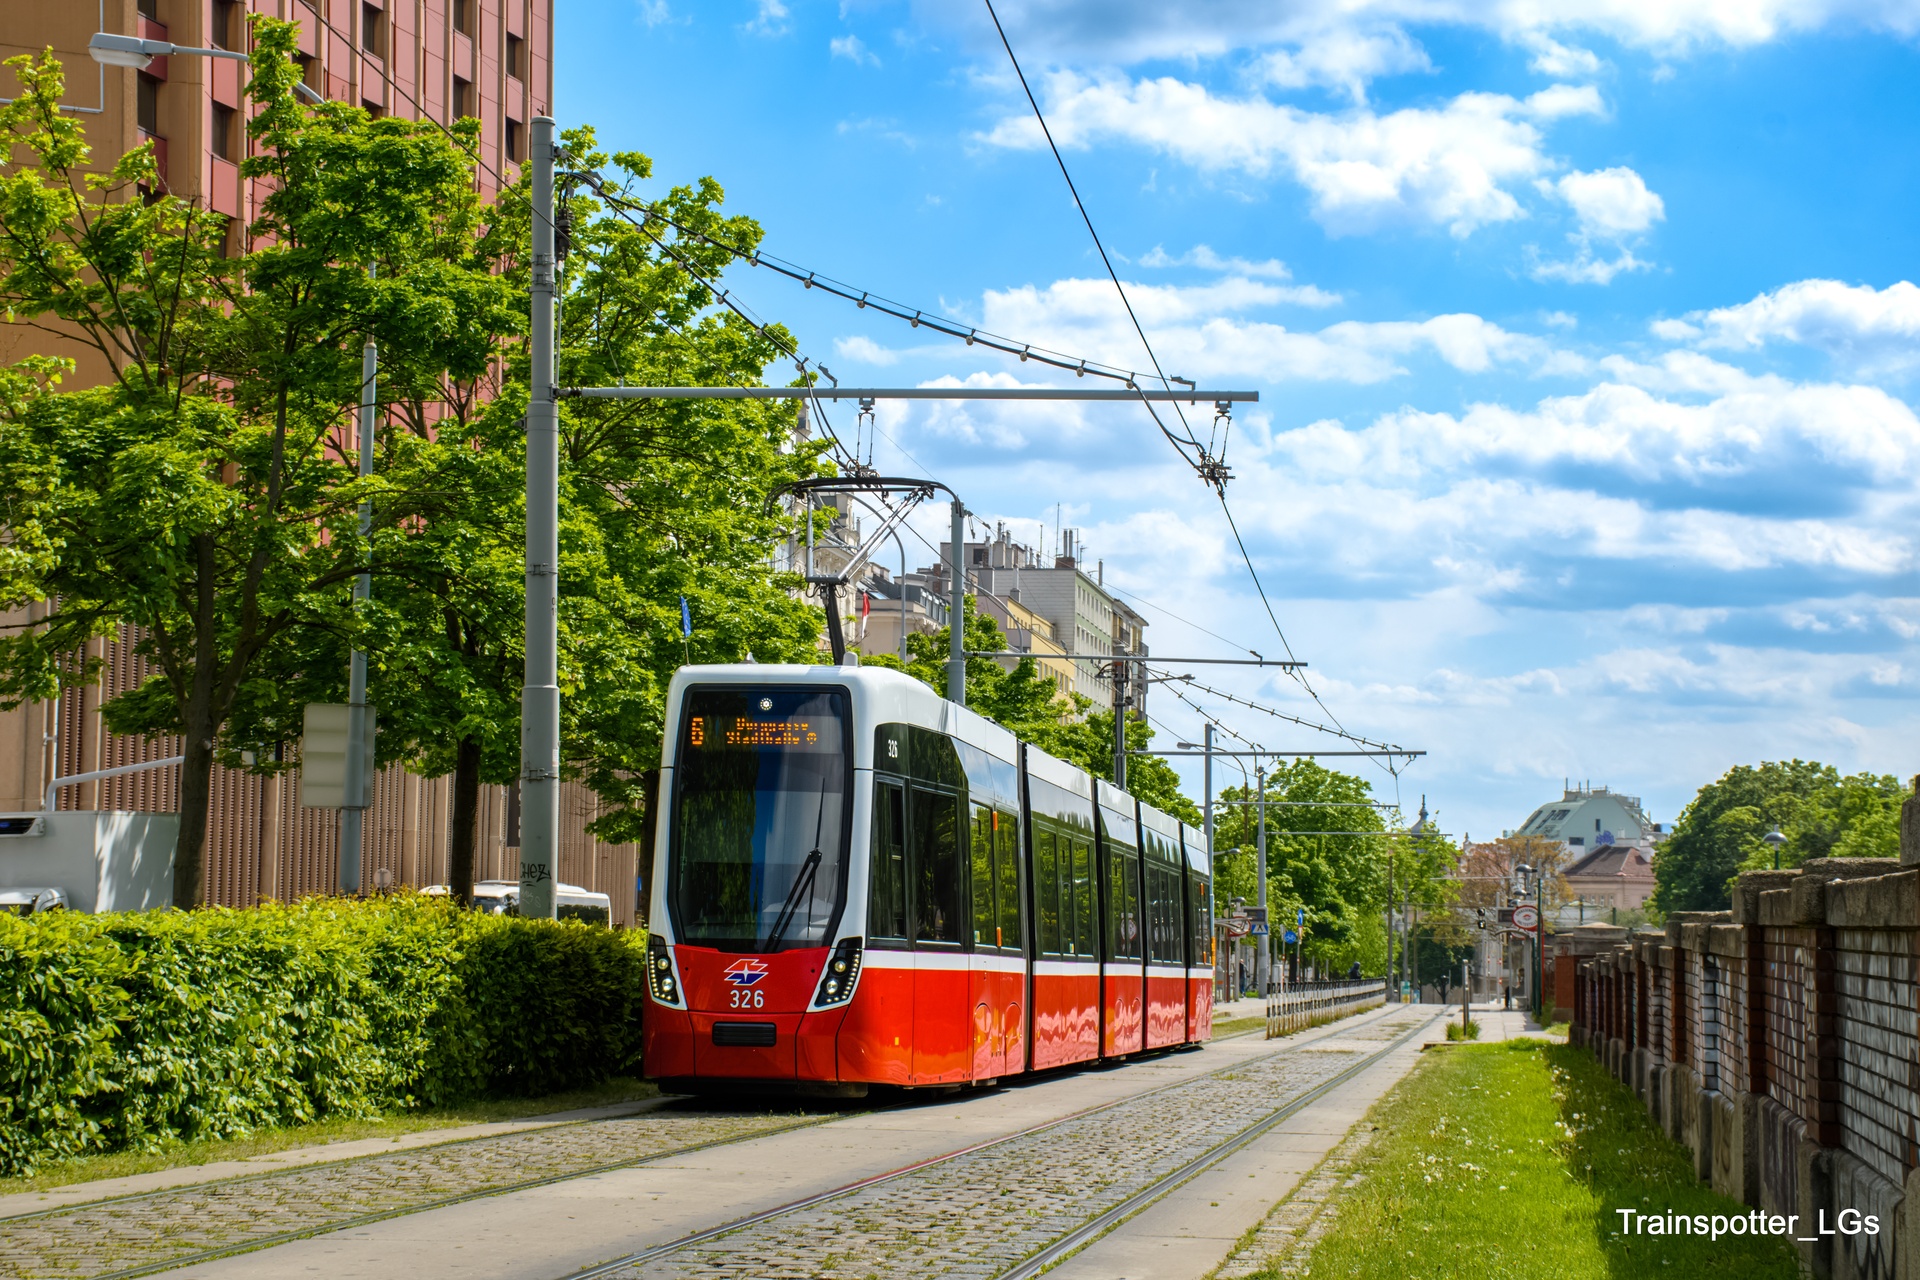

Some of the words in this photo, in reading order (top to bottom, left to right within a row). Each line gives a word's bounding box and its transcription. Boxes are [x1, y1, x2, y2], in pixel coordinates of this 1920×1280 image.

[691, 717, 703, 745] 6
[888, 739, 898, 758] 326
[729, 989, 765, 1009] 326
